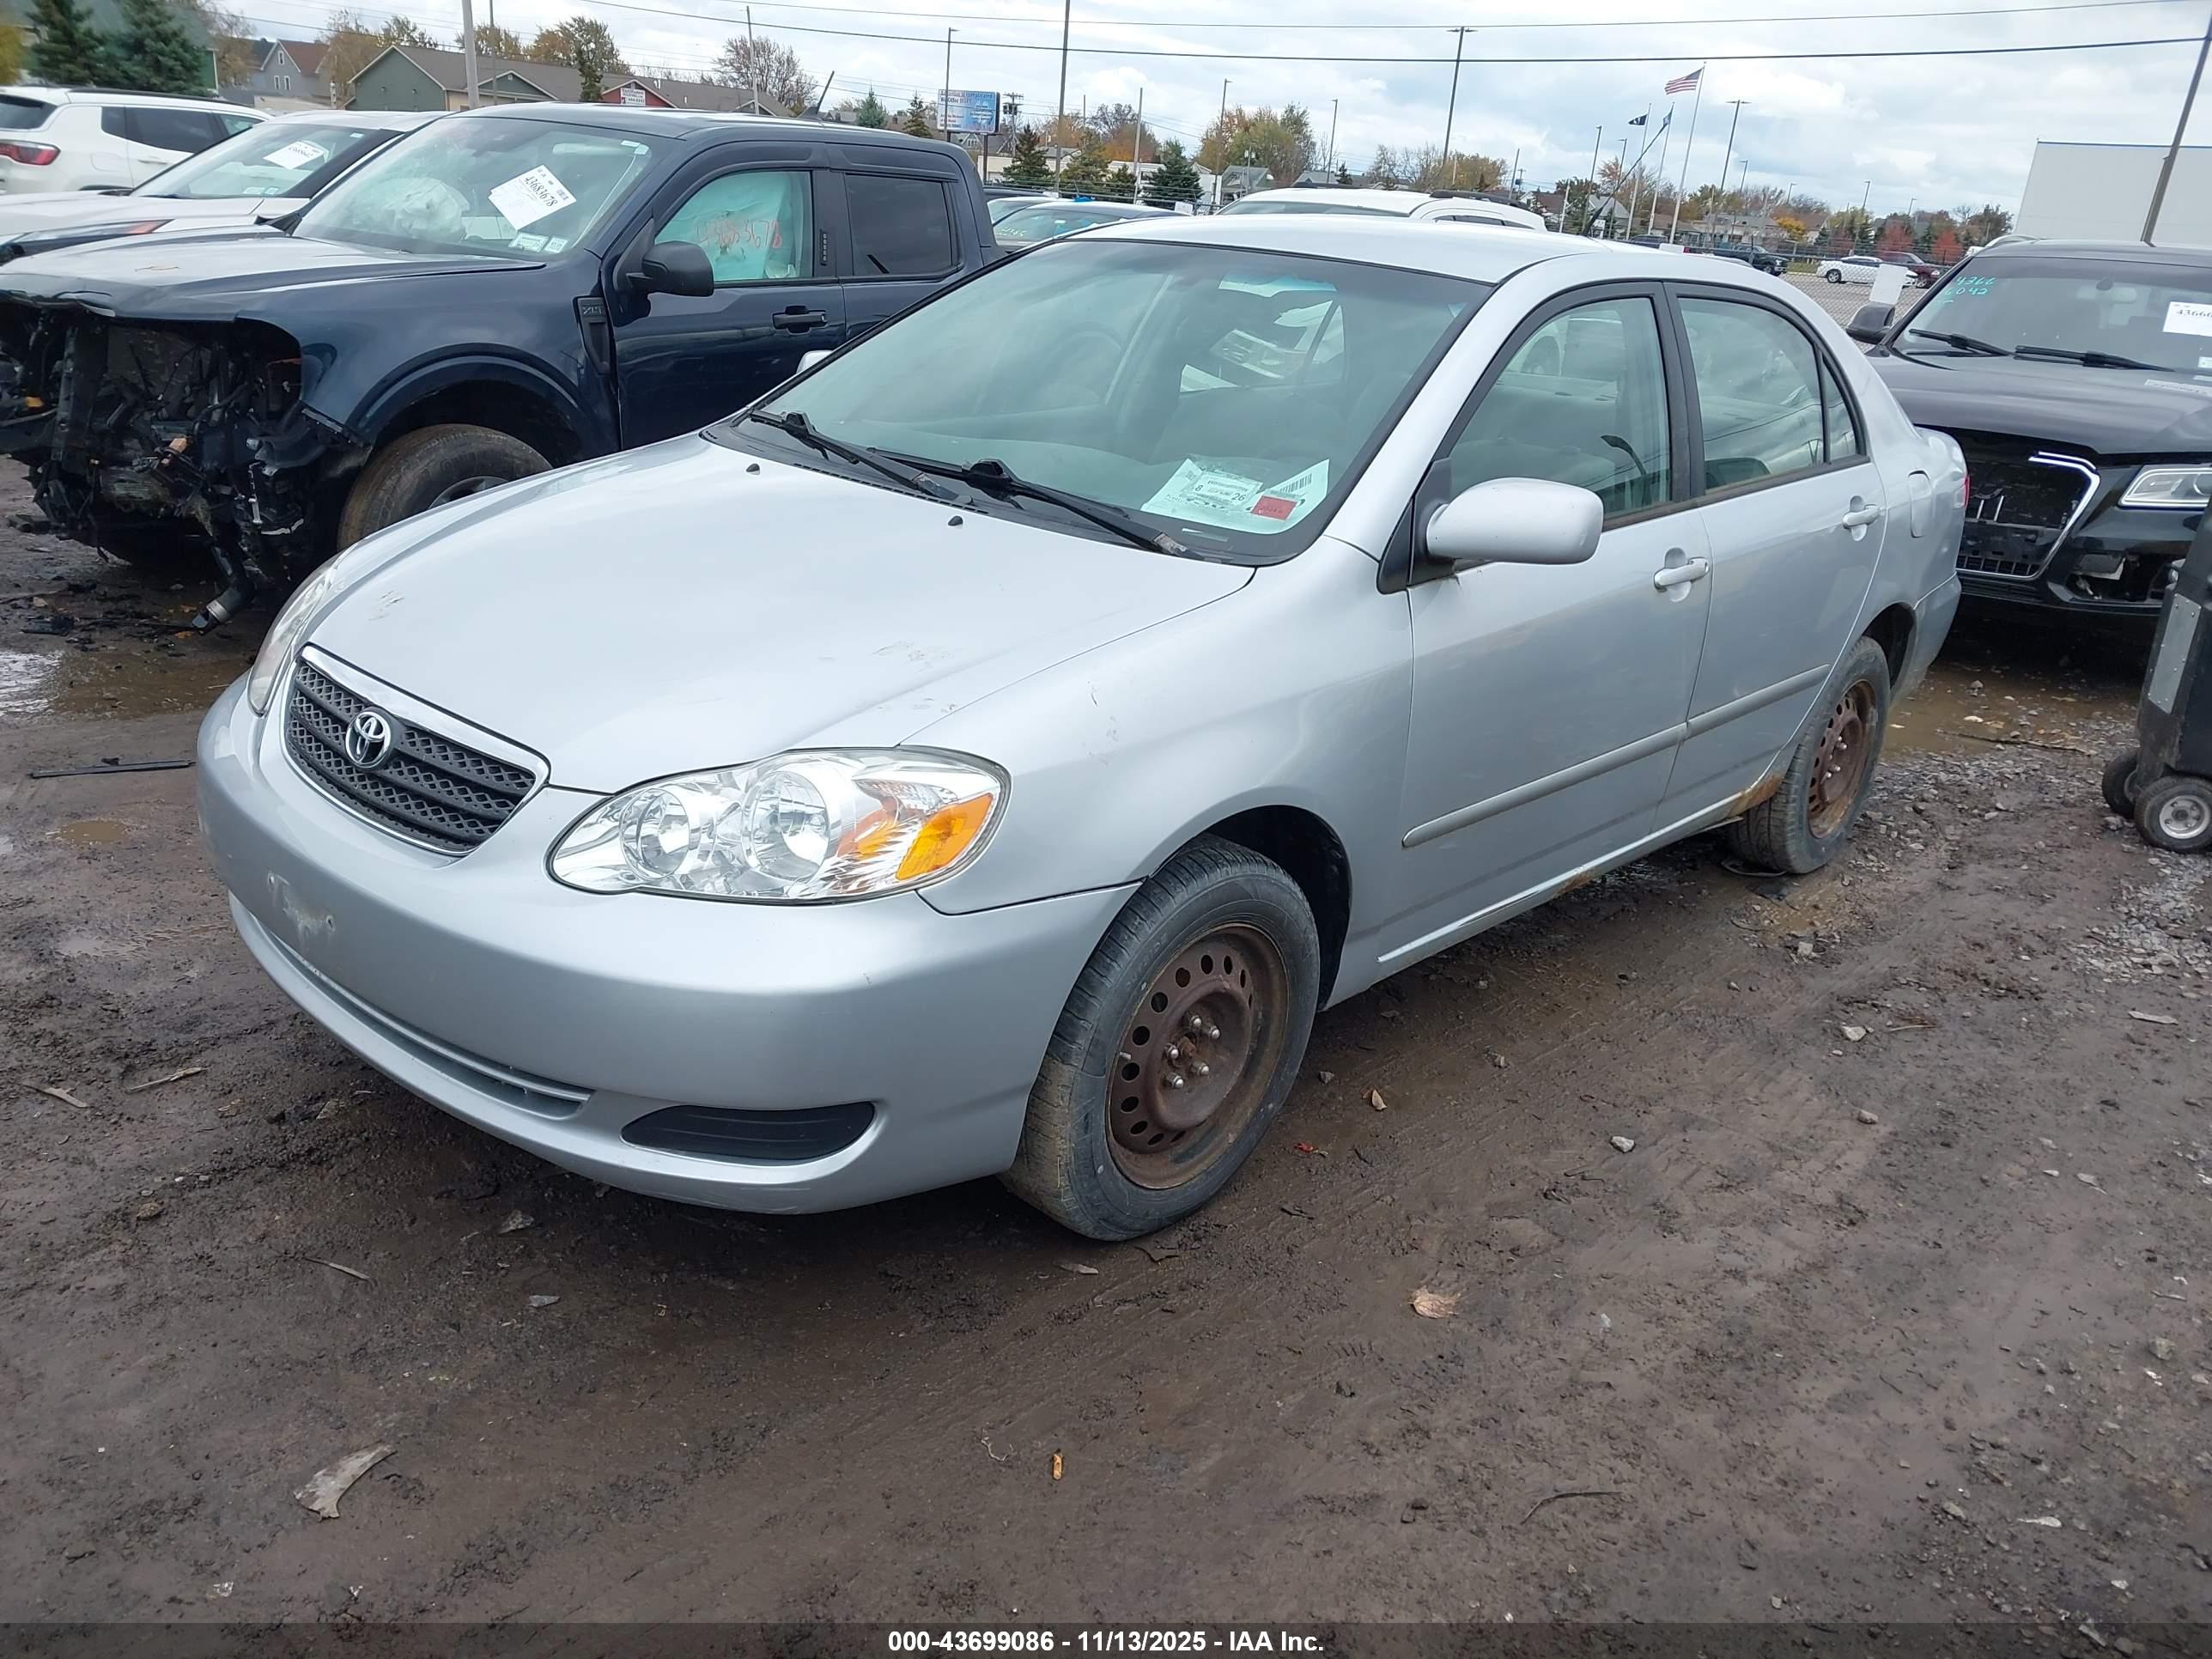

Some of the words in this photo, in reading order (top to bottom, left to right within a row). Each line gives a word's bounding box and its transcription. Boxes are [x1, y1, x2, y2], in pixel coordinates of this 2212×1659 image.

[1956, 276, 1996, 286] 4366
[1194, 483, 1204, 492] 8
[1231, 492, 1247, 501] 26
